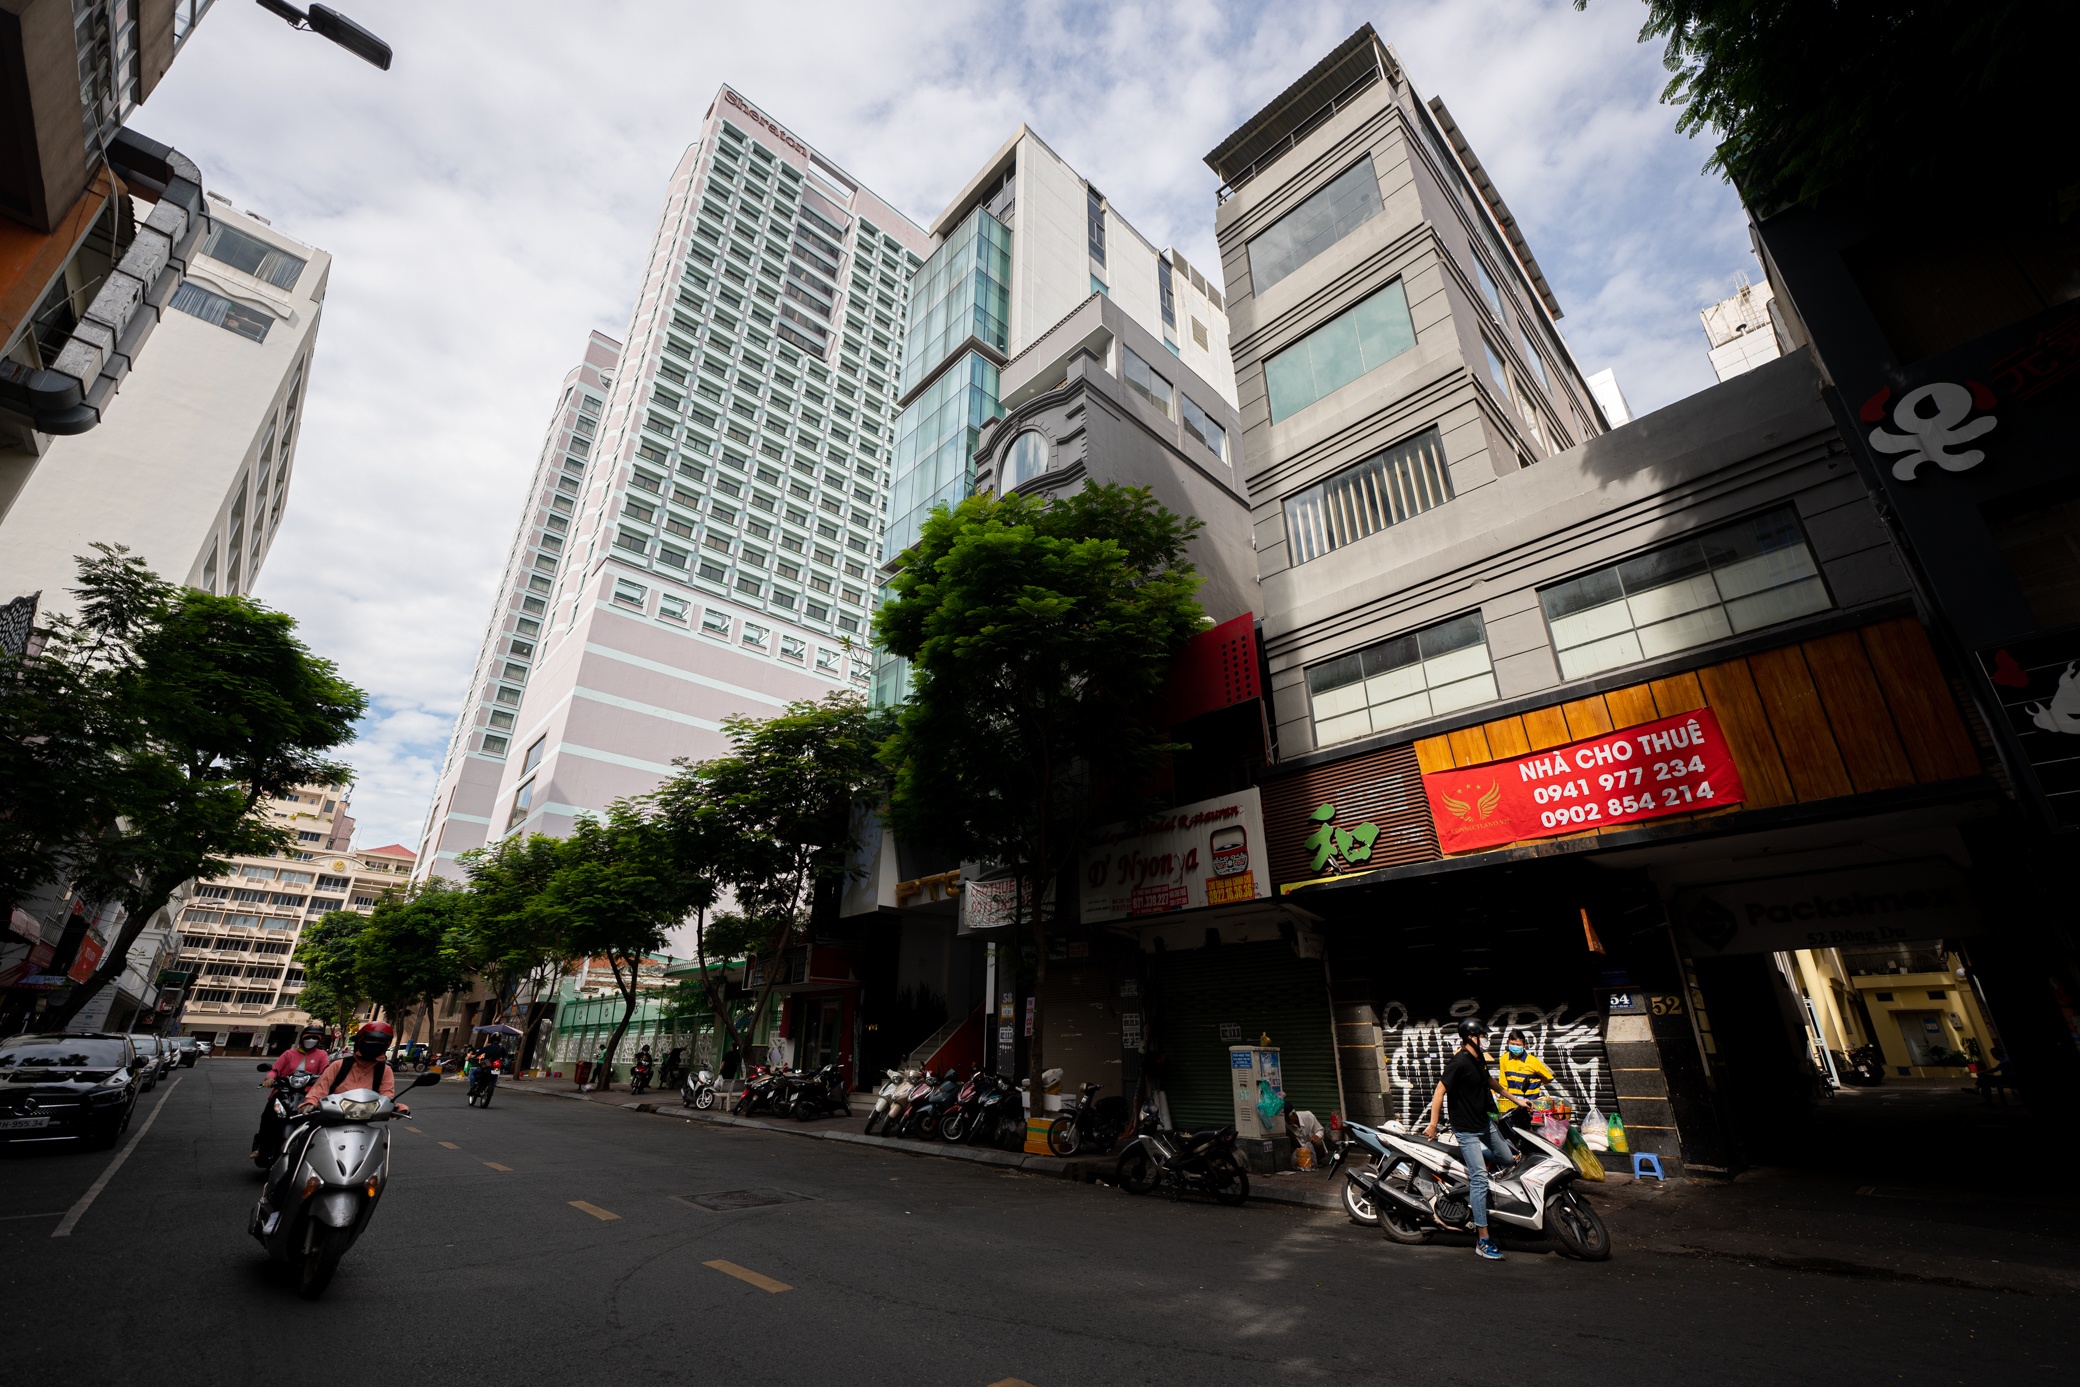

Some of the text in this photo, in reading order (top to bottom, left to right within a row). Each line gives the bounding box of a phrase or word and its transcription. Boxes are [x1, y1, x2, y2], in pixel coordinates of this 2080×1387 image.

[724, 89, 807, 158] Sheraton
[1518, 718, 1705, 782] NHÀ CHO THUÊ
[1533, 754, 1706, 804] 0941 977 234
[1540, 780, 1715, 828] 0902 854 214
[1745, 887, 1959, 925] Packsimex
[1807, 932, 1827, 945] 52
[1879, 926, 1907, 940] Du
[1003, 992, 1013, 1004] 58
[1610, 993, 1631, 1006] 54
[1651, 996, 1683, 1016] 52
[0, 1120, 44, 1129] H-955.34
